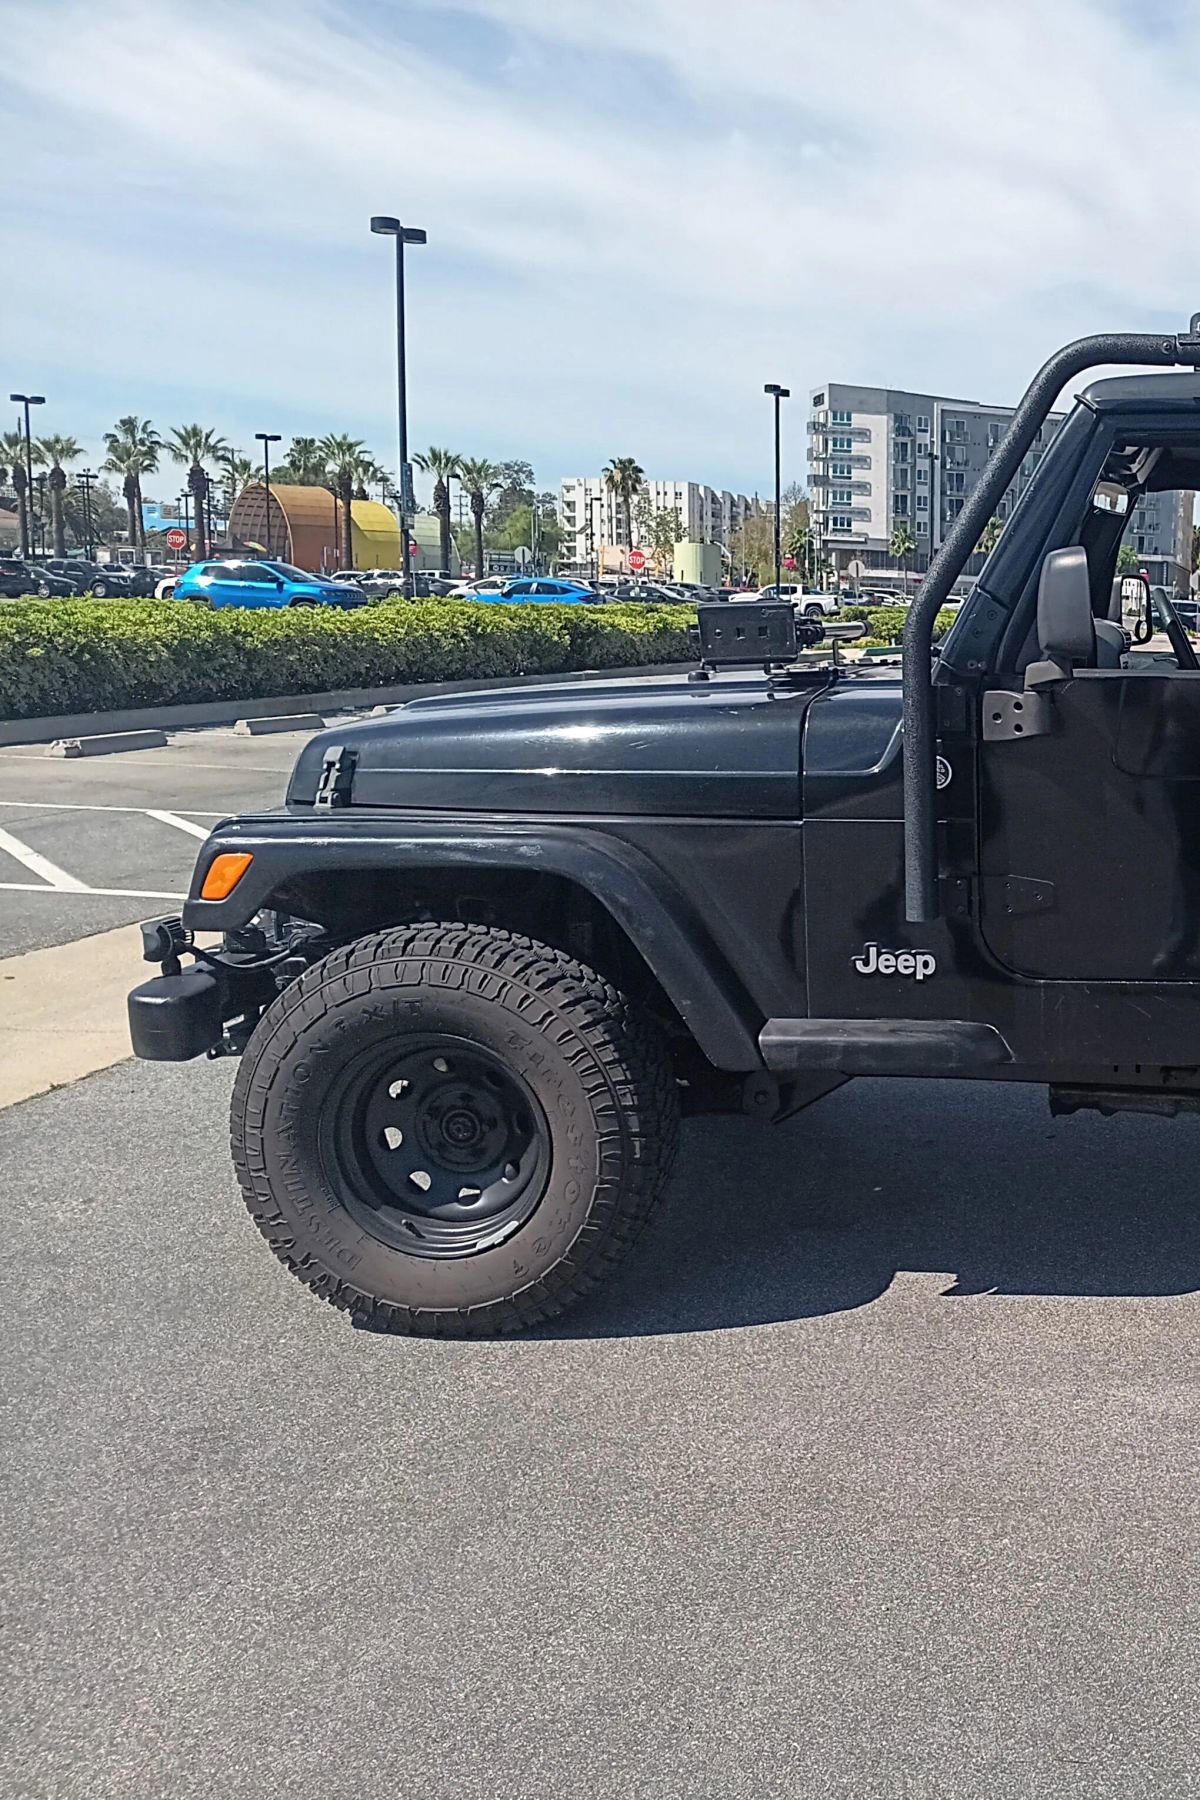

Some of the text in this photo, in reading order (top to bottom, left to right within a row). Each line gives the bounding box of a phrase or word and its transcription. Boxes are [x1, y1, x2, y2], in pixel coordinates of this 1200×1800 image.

[168, 535, 184, 544] STOP
[629, 556, 645, 565] STOP
[853, 946, 936, 980] Jeep
